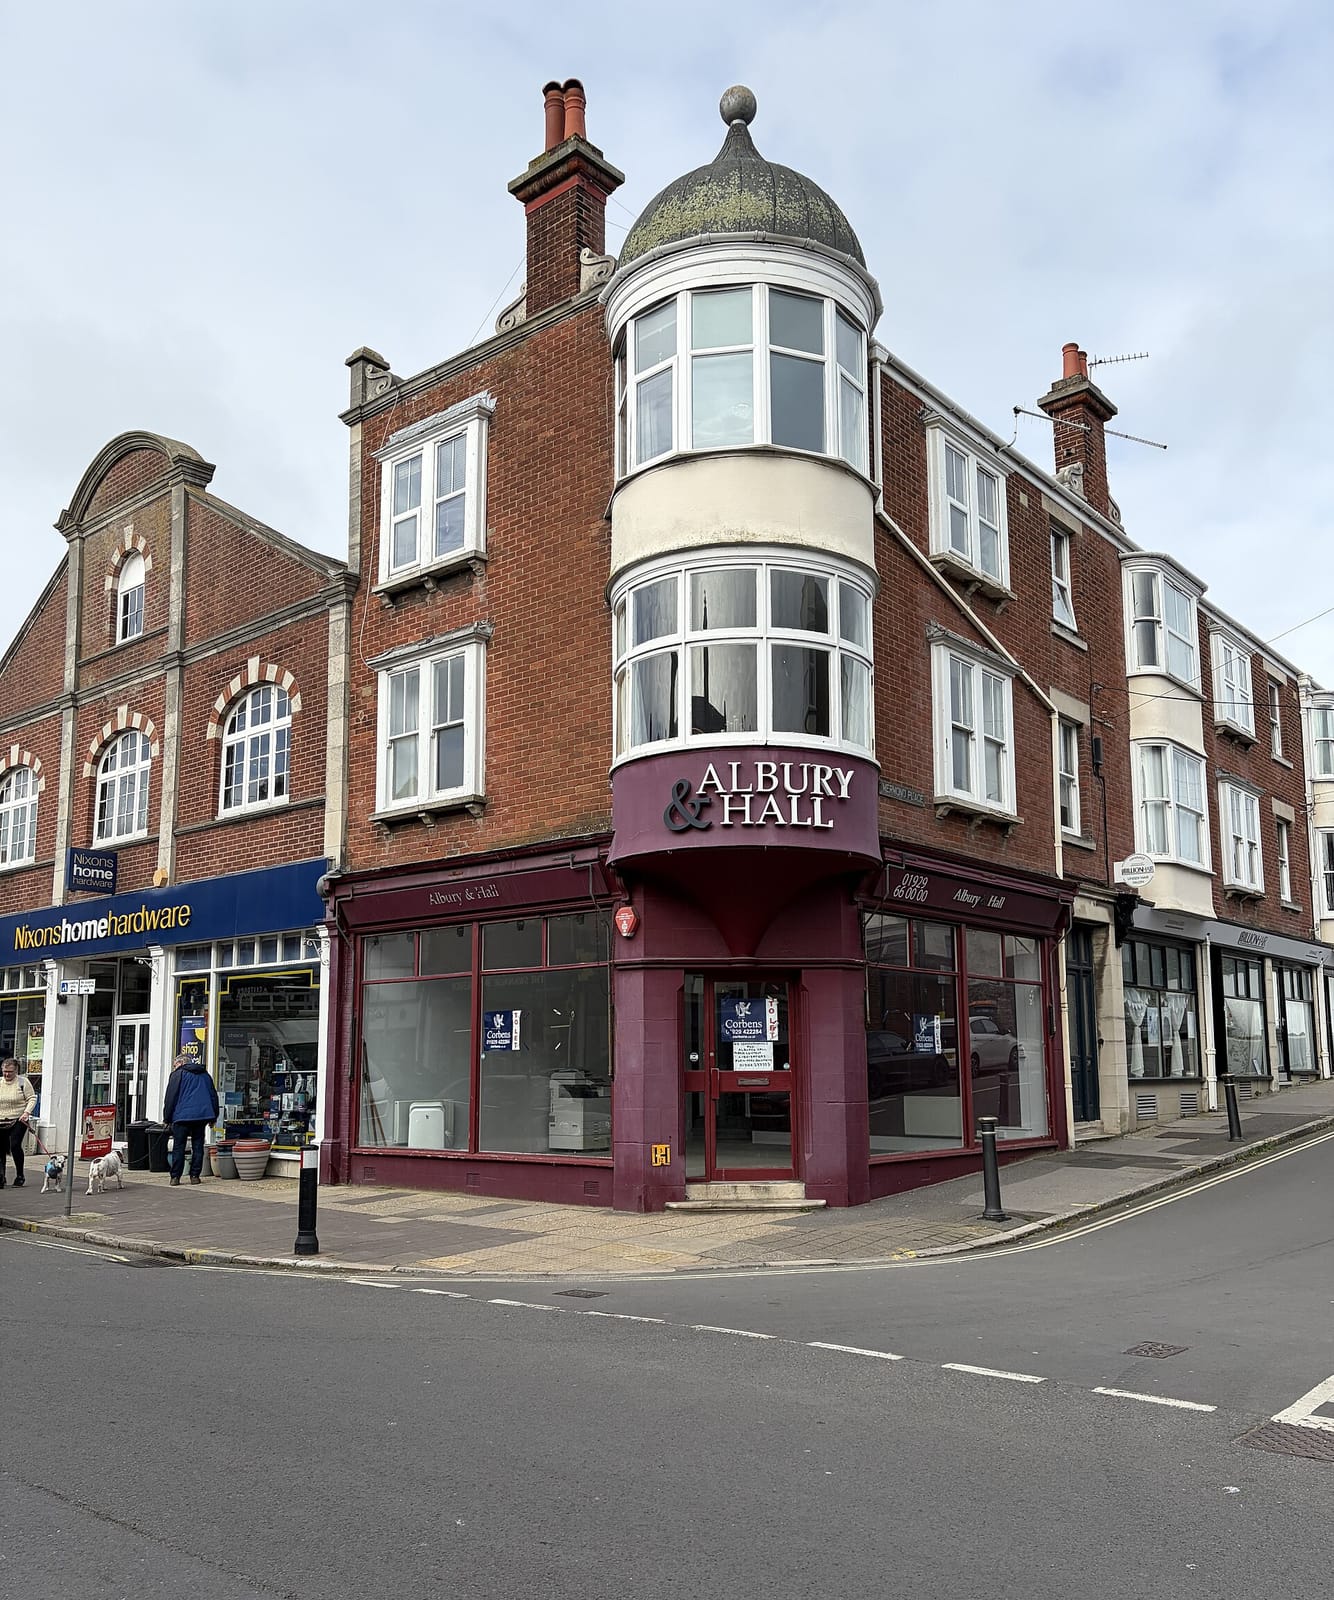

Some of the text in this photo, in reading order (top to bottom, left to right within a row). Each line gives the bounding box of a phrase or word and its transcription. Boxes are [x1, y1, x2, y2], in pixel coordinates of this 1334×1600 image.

[696, 761, 855, 799] ALBURY
[663, 778, 834, 832] & HALL
[73, 853, 114, 868] Nixons
[73, 863, 114, 880] home
[72, 876, 113, 888] hardware
[902, 873, 929, 889] 01929
[429, 883, 500, 906] Albury & Hall
[953, 888, 982, 909] Albury
[987, 895, 1006, 909] Hall
[725, 1019, 763, 1029] Corbens
[486, 1030, 511, 1039] Corbens
[181, 1043, 198, 1056] shop
